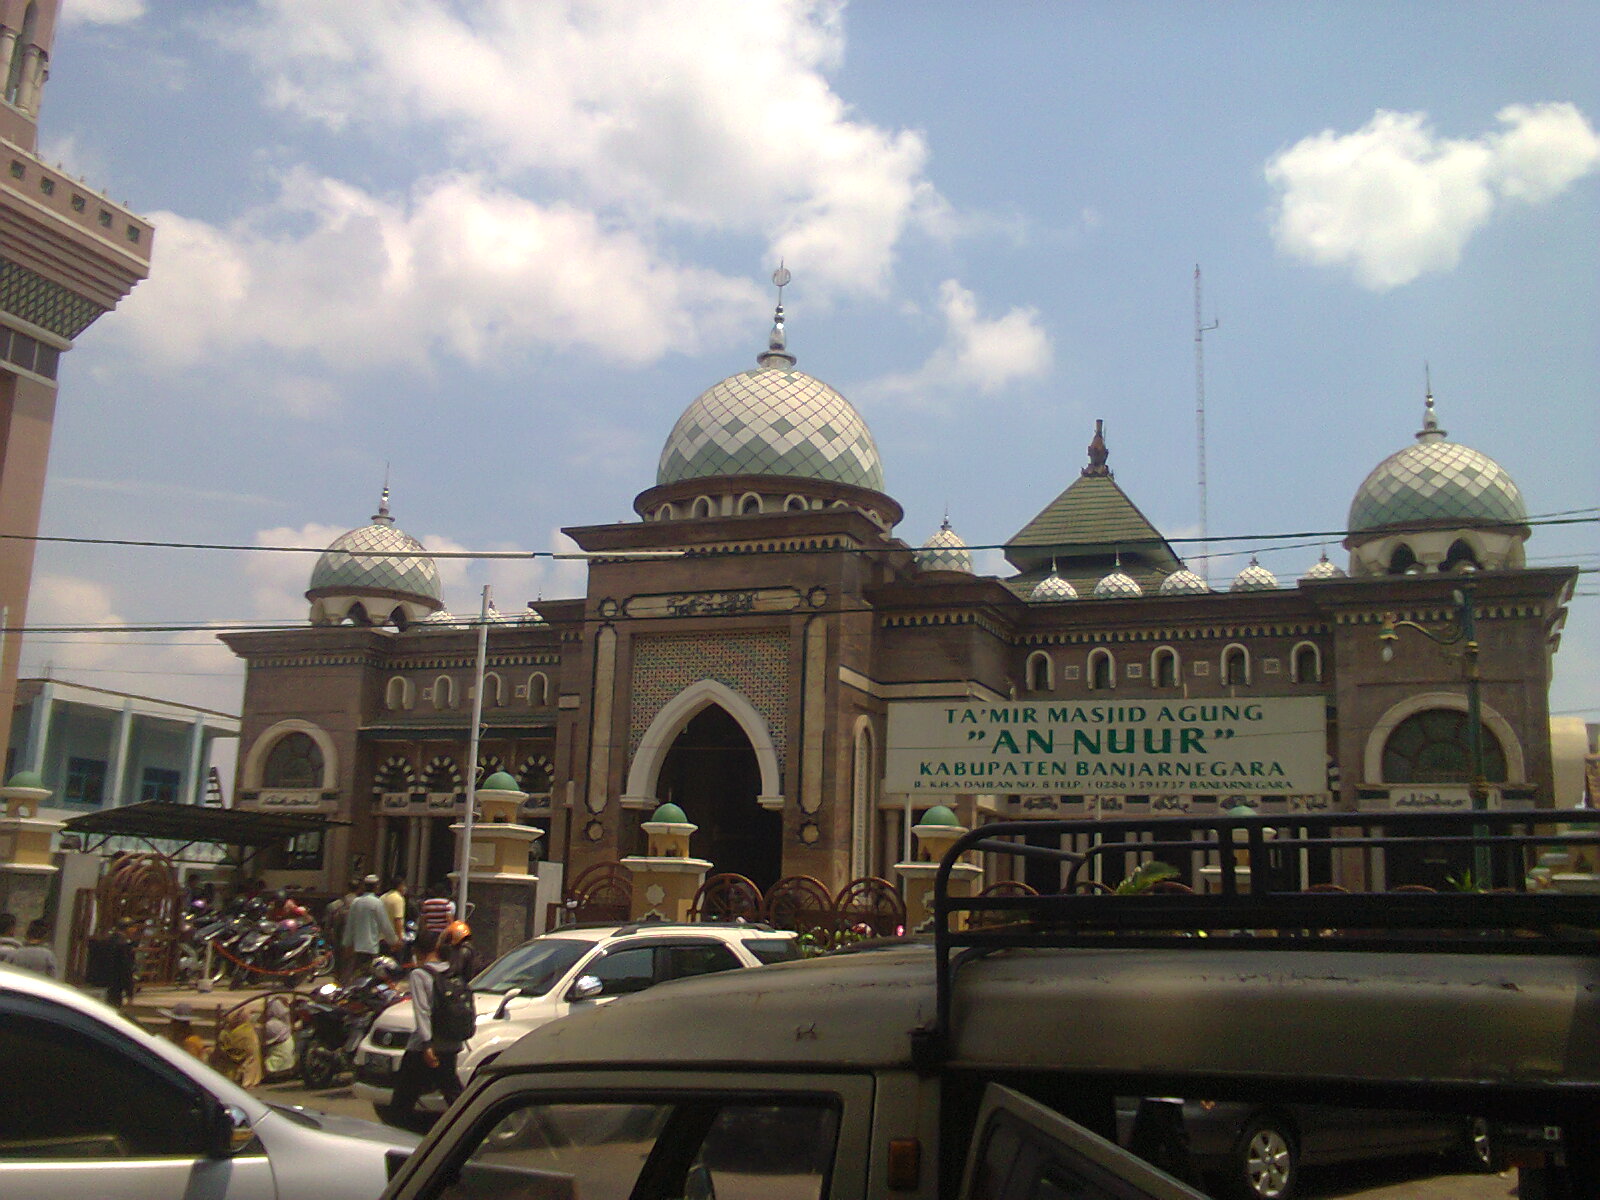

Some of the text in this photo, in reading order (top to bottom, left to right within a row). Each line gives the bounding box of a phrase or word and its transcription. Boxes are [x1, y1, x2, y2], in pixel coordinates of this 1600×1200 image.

[944, 704, 1263, 723] TA'MIR MASJID AGUNG
[919, 761, 1285, 777] KABUPATEN BANJARNEGARA
